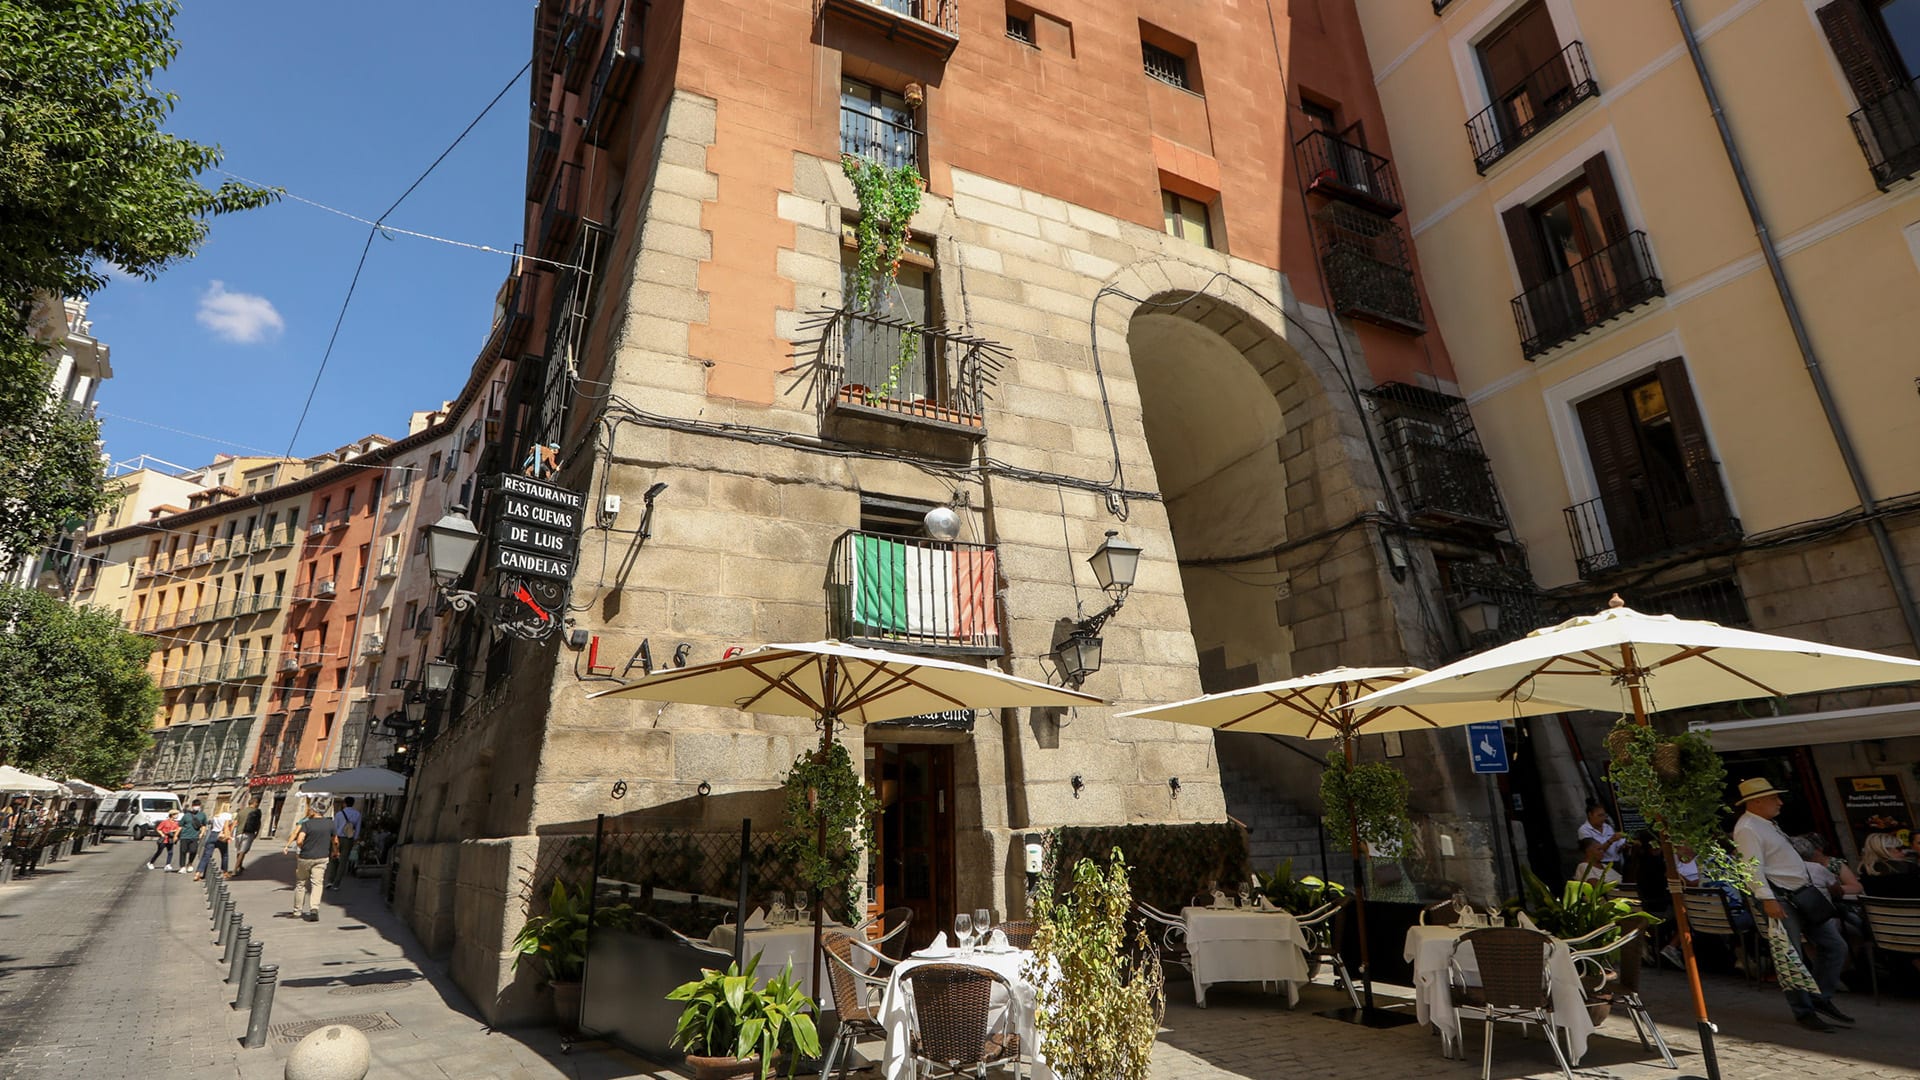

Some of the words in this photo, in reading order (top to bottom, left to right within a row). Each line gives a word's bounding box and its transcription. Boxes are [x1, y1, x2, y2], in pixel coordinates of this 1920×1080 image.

[504, 476, 579, 507] RESTAURANTE
[507, 500, 529, 518] LAS
[532, 507, 572, 528] CUEVAS
[510, 526, 529, 543] DE
[534, 532, 564, 550] LUIS
[501, 551, 568, 577] CANDELAS
